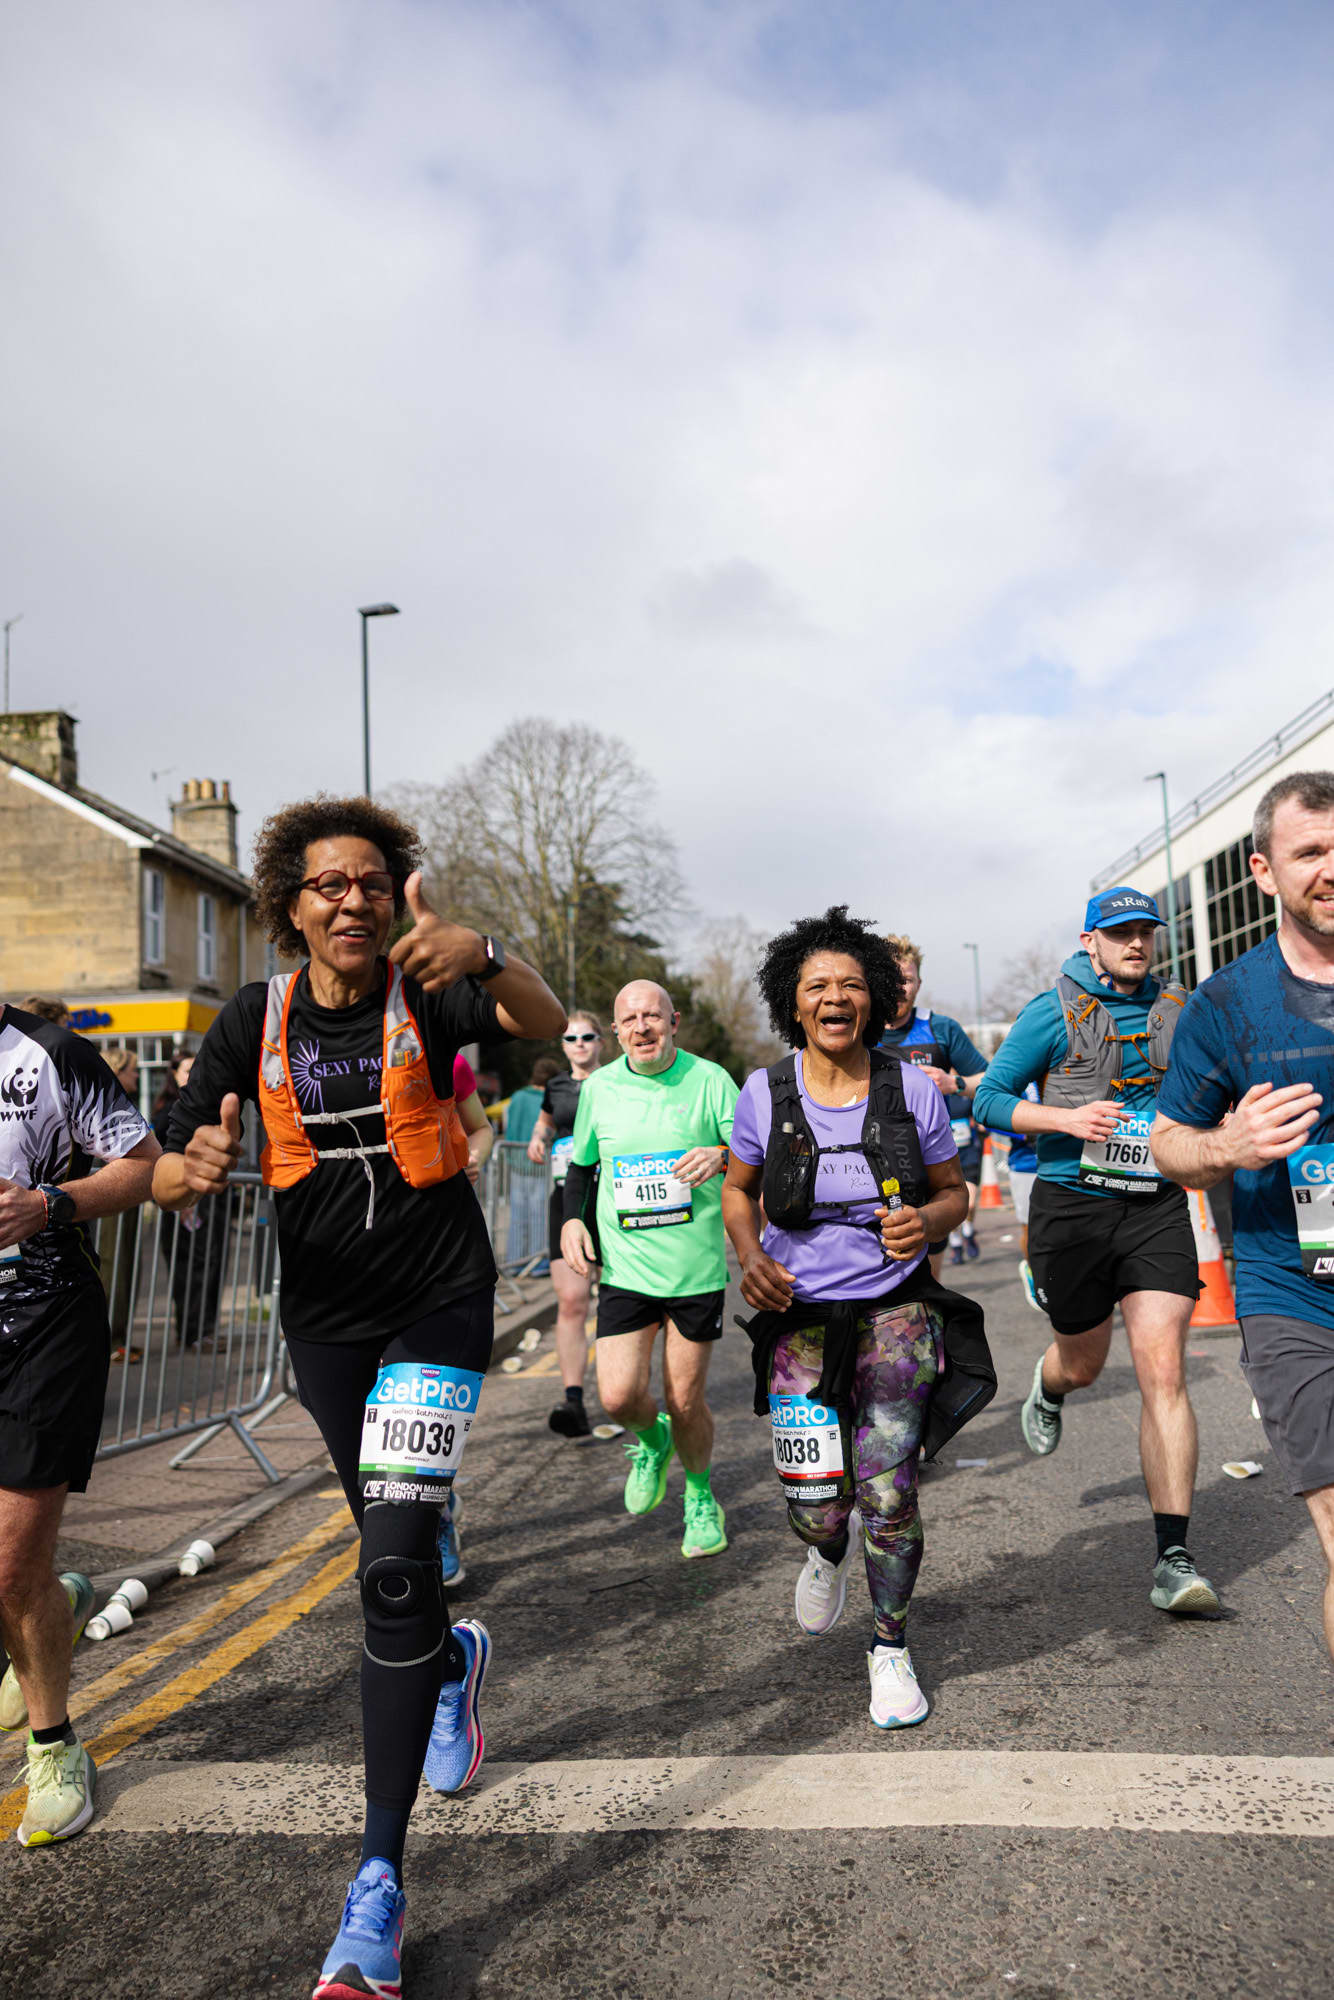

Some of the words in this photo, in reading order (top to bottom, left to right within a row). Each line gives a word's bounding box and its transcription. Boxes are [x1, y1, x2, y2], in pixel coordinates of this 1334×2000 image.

[1123, 896, 1149, 909] Rab
[313, 1059, 352, 1078] SEXY
[0, 1109, 38, 1122] WWF
[1105, 1142, 1149, 1165] 17667
[844, 1163, 872, 1175] PAC
[635, 1182, 667, 1202] 4115
[376, 1376, 471, 1409] GetPRO
[382, 1418, 456, 1457] 18039
[385, 1480, 422, 1493] LONDON
[799, 1484, 837, 1493] MARATHON
[384, 1489, 417, 1500] EVENTS
